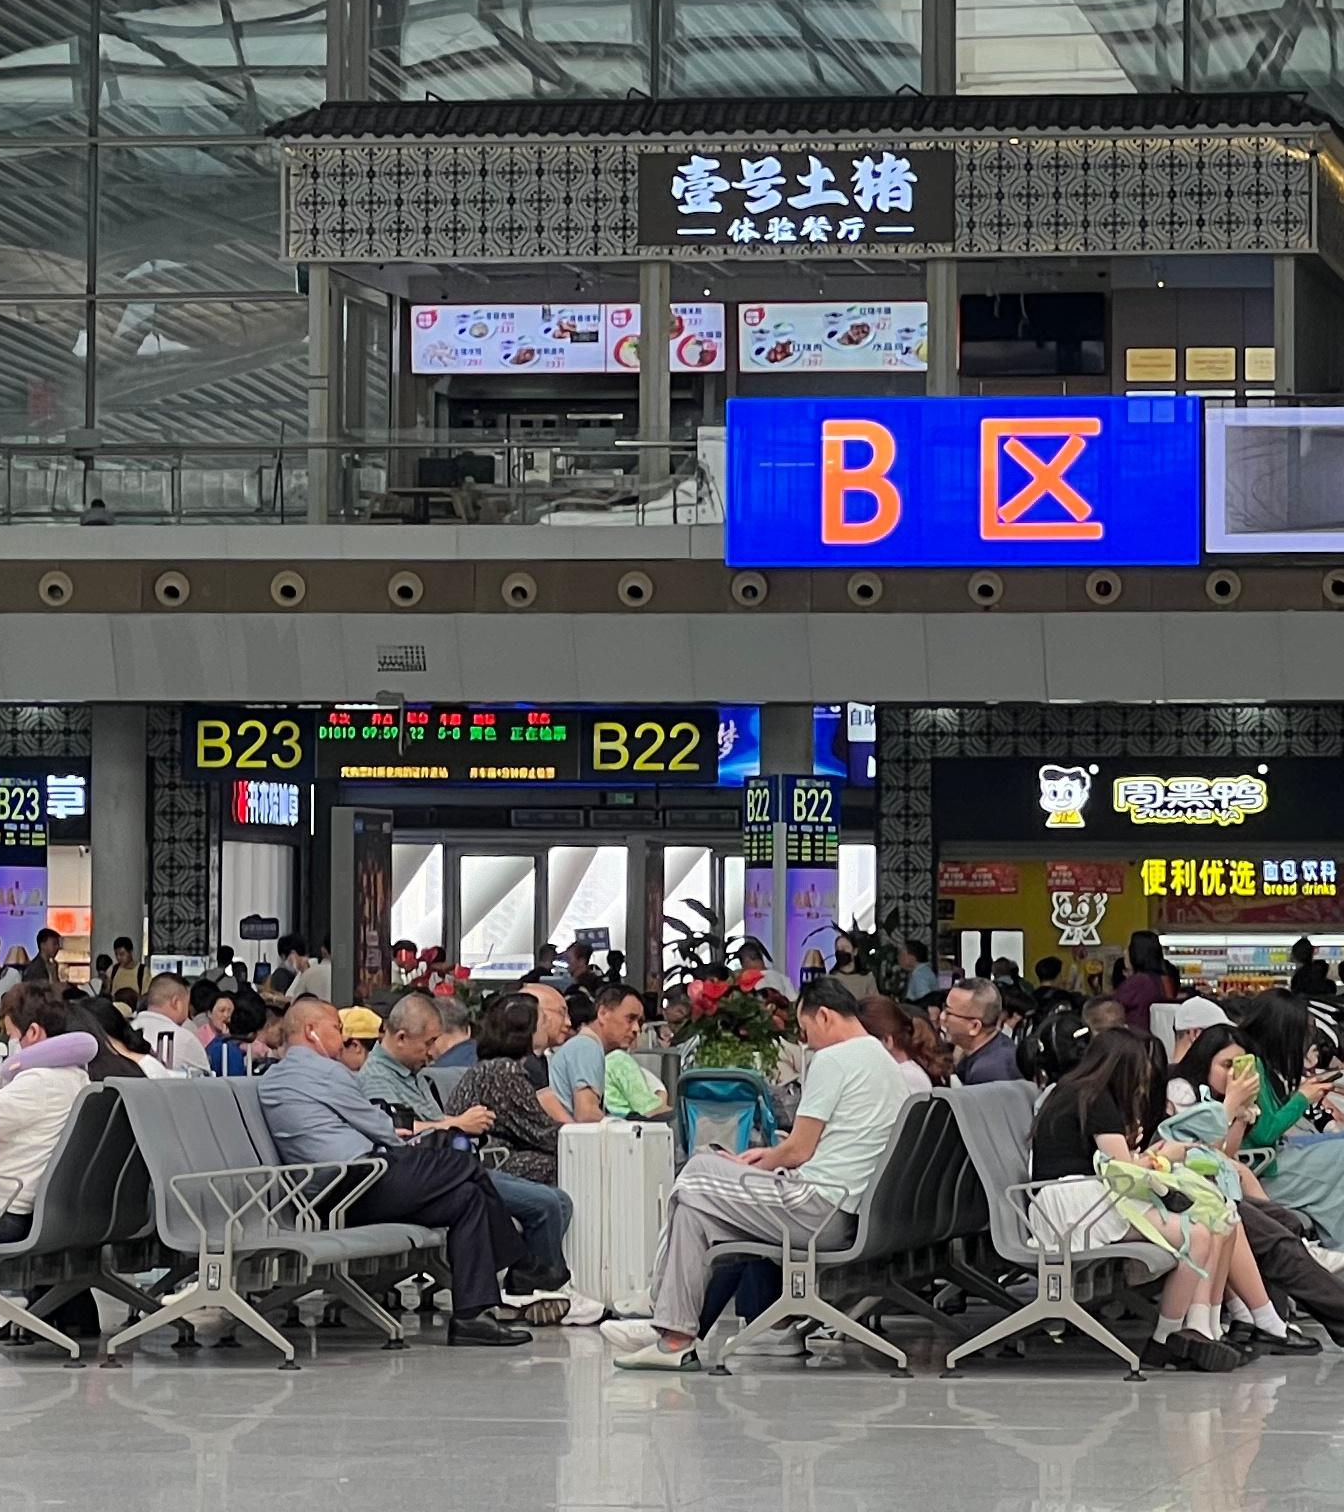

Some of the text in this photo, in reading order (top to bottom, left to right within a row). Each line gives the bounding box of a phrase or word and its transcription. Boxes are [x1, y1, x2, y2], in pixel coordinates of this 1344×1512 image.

[671, 151, 918, 215] 壹号土猪
[726, 216, 866, 243] 体验餐厅
[820, 417, 1103, 545] B 区
[197, 720, 303, 769] B23
[362, 726, 398, 739] 09:59
[510, 726, 567, 741] 正在检票
[592, 722, 702, 771] B22
[747, 788, 770, 822] B22
[793, 788, 833, 823] B22
[1117, 780, 1264, 810] 周黑鸭
[1140, 859, 1256, 897] 便利优选
[1263, 882, 1337, 896] bread drinks
